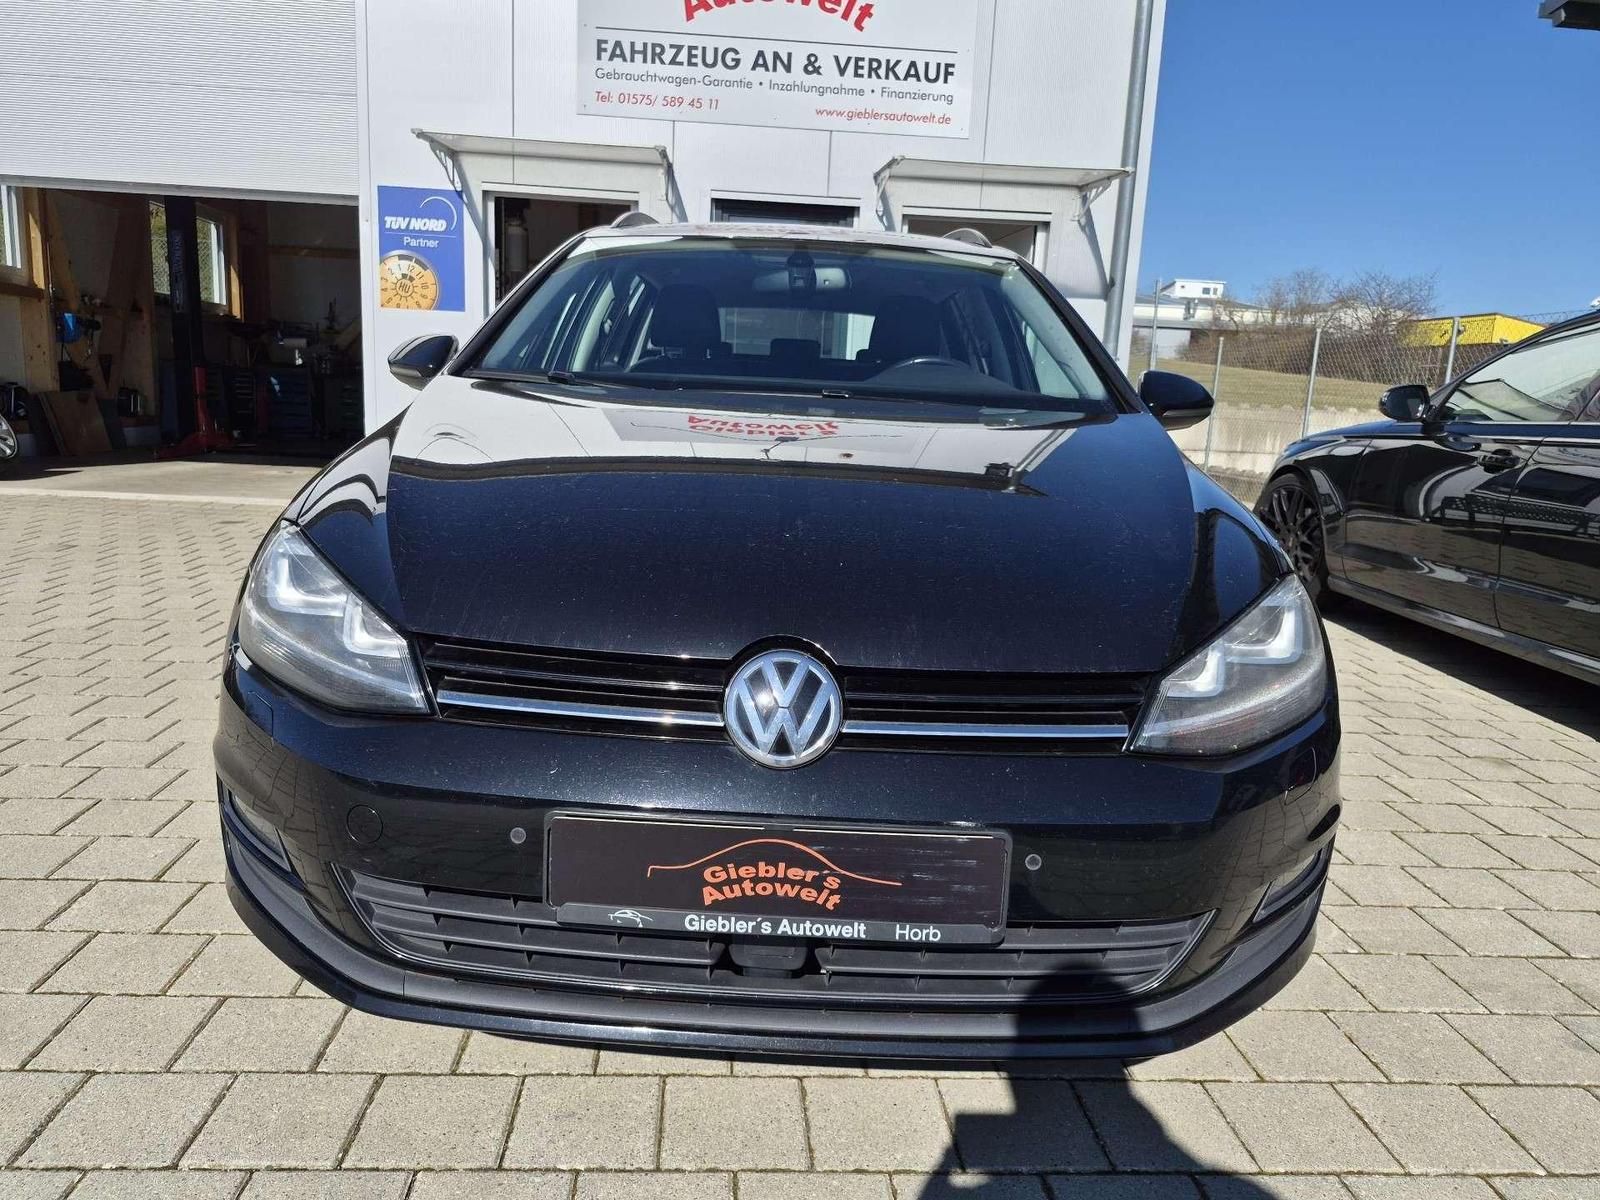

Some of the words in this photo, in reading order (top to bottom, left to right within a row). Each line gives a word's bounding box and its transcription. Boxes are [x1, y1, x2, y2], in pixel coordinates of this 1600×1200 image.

[686, 0, 874, 32] Aelt
[595, 38, 742, 71] FAHRZEUG
[750, 49, 793, 74] AN
[802, 52, 823, 76] &
[833, 54, 956, 84] VERKAUF
[594, 67, 753, 90] Gebrauchtwagen-Garantie
[769, 79, 865, 97] Inzahlungnahme
[880, 86, 954, 105] Finanzierung
[595, 91, 613, 103] Tel:
[617, 92, 658, 107] 01575/
[661, 96, 685, 108] 589
[687, 99, 703, 110] 45
[708, 98, 720, 111] 11
[815, 107, 952, 125] www.gieblersautowelt.de
[409, 217, 447, 232] NORD
[403, 236, 440, 248] Partner
[398, 280, 411, 294] HU
[702, 879, 842, 911] Autowelt
[777, 918, 867, 939] Autowelt
[895, 924, 942, 942] Horb
